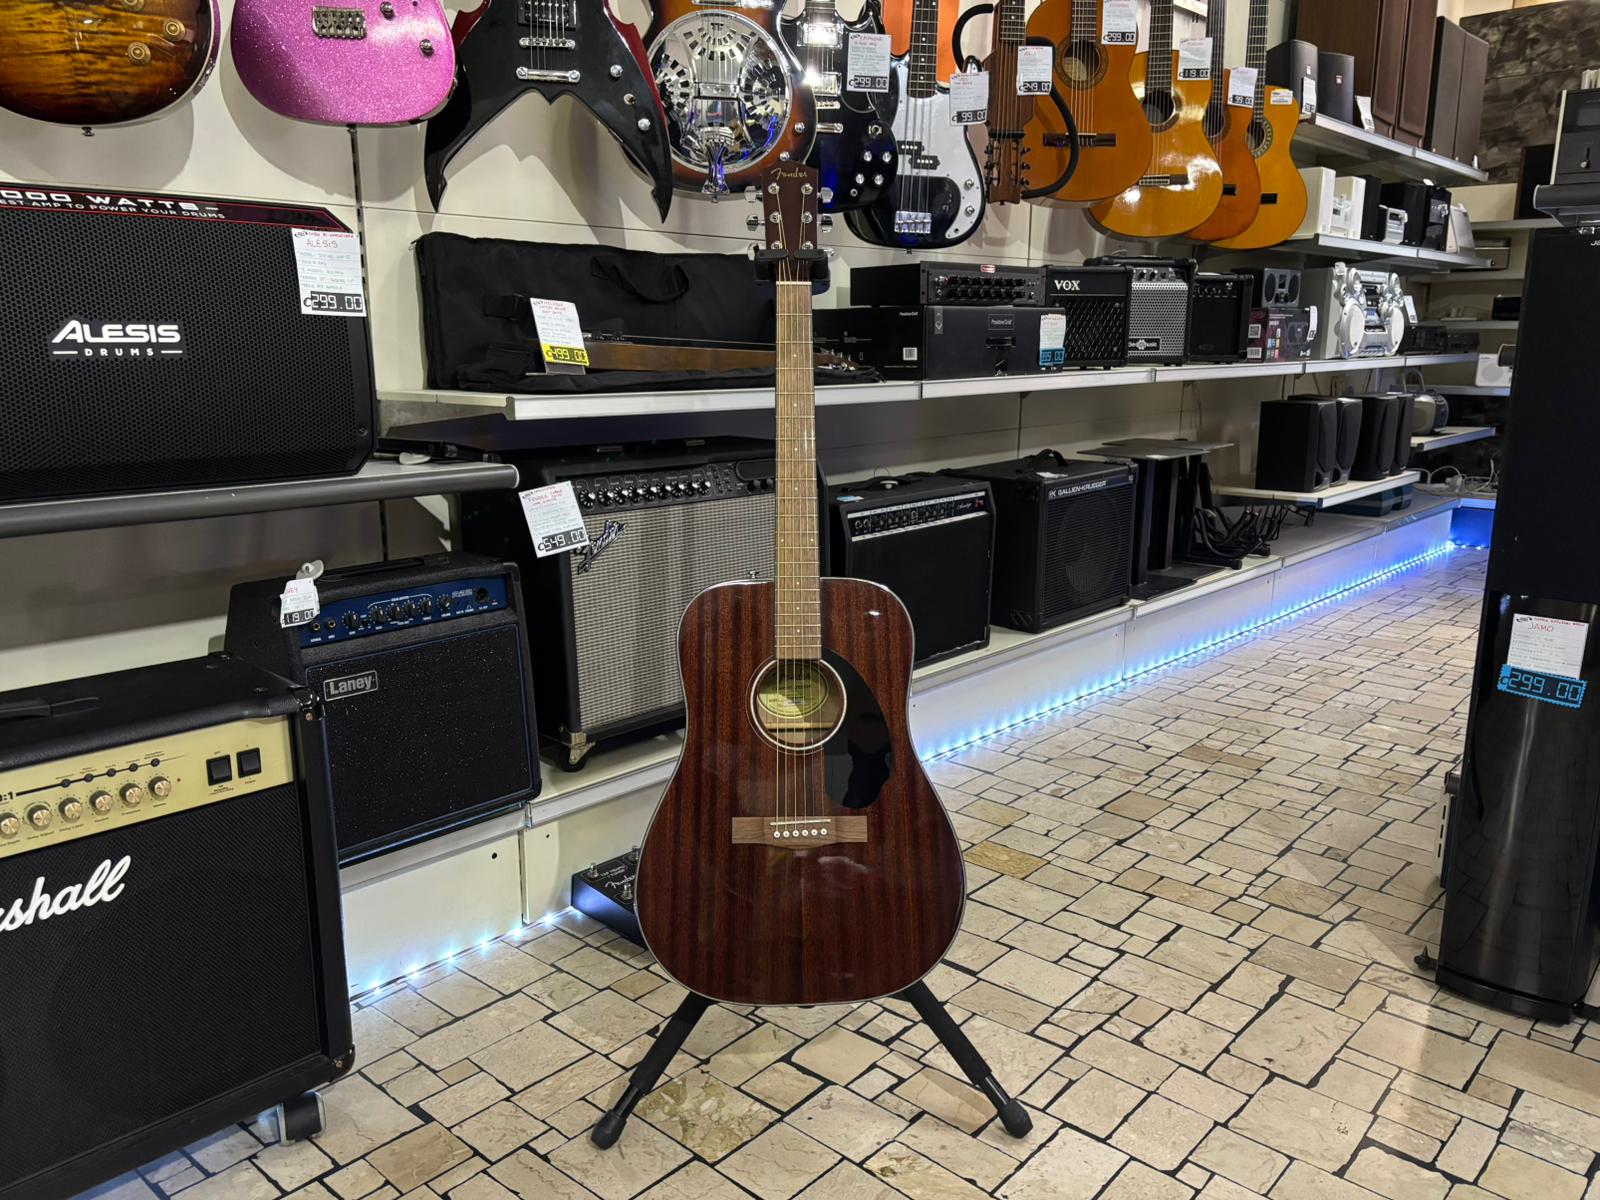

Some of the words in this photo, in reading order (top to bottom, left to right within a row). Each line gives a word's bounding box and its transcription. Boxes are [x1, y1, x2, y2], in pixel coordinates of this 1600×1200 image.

[771, 167, 808, 180] Fender
[32, 201, 61, 209] AMP
[67, 202, 84, 210] TO
[90, 204, 137, 213] POWER
[143, 207, 178, 216] YOUR
[182, 211, 226, 219] DRUMS
[86, 194, 199, 211] WATTS
[1054, 279, 1081, 291] VOX
[51, 319, 181, 343] ALESIS
[84, 348, 154, 357] DRUMS
[1057, 480, 1107, 496] GALLIEN-KRUEGER
[1527, 623, 1554, 633] JAMO
[330, 676, 373, 695] Laney
